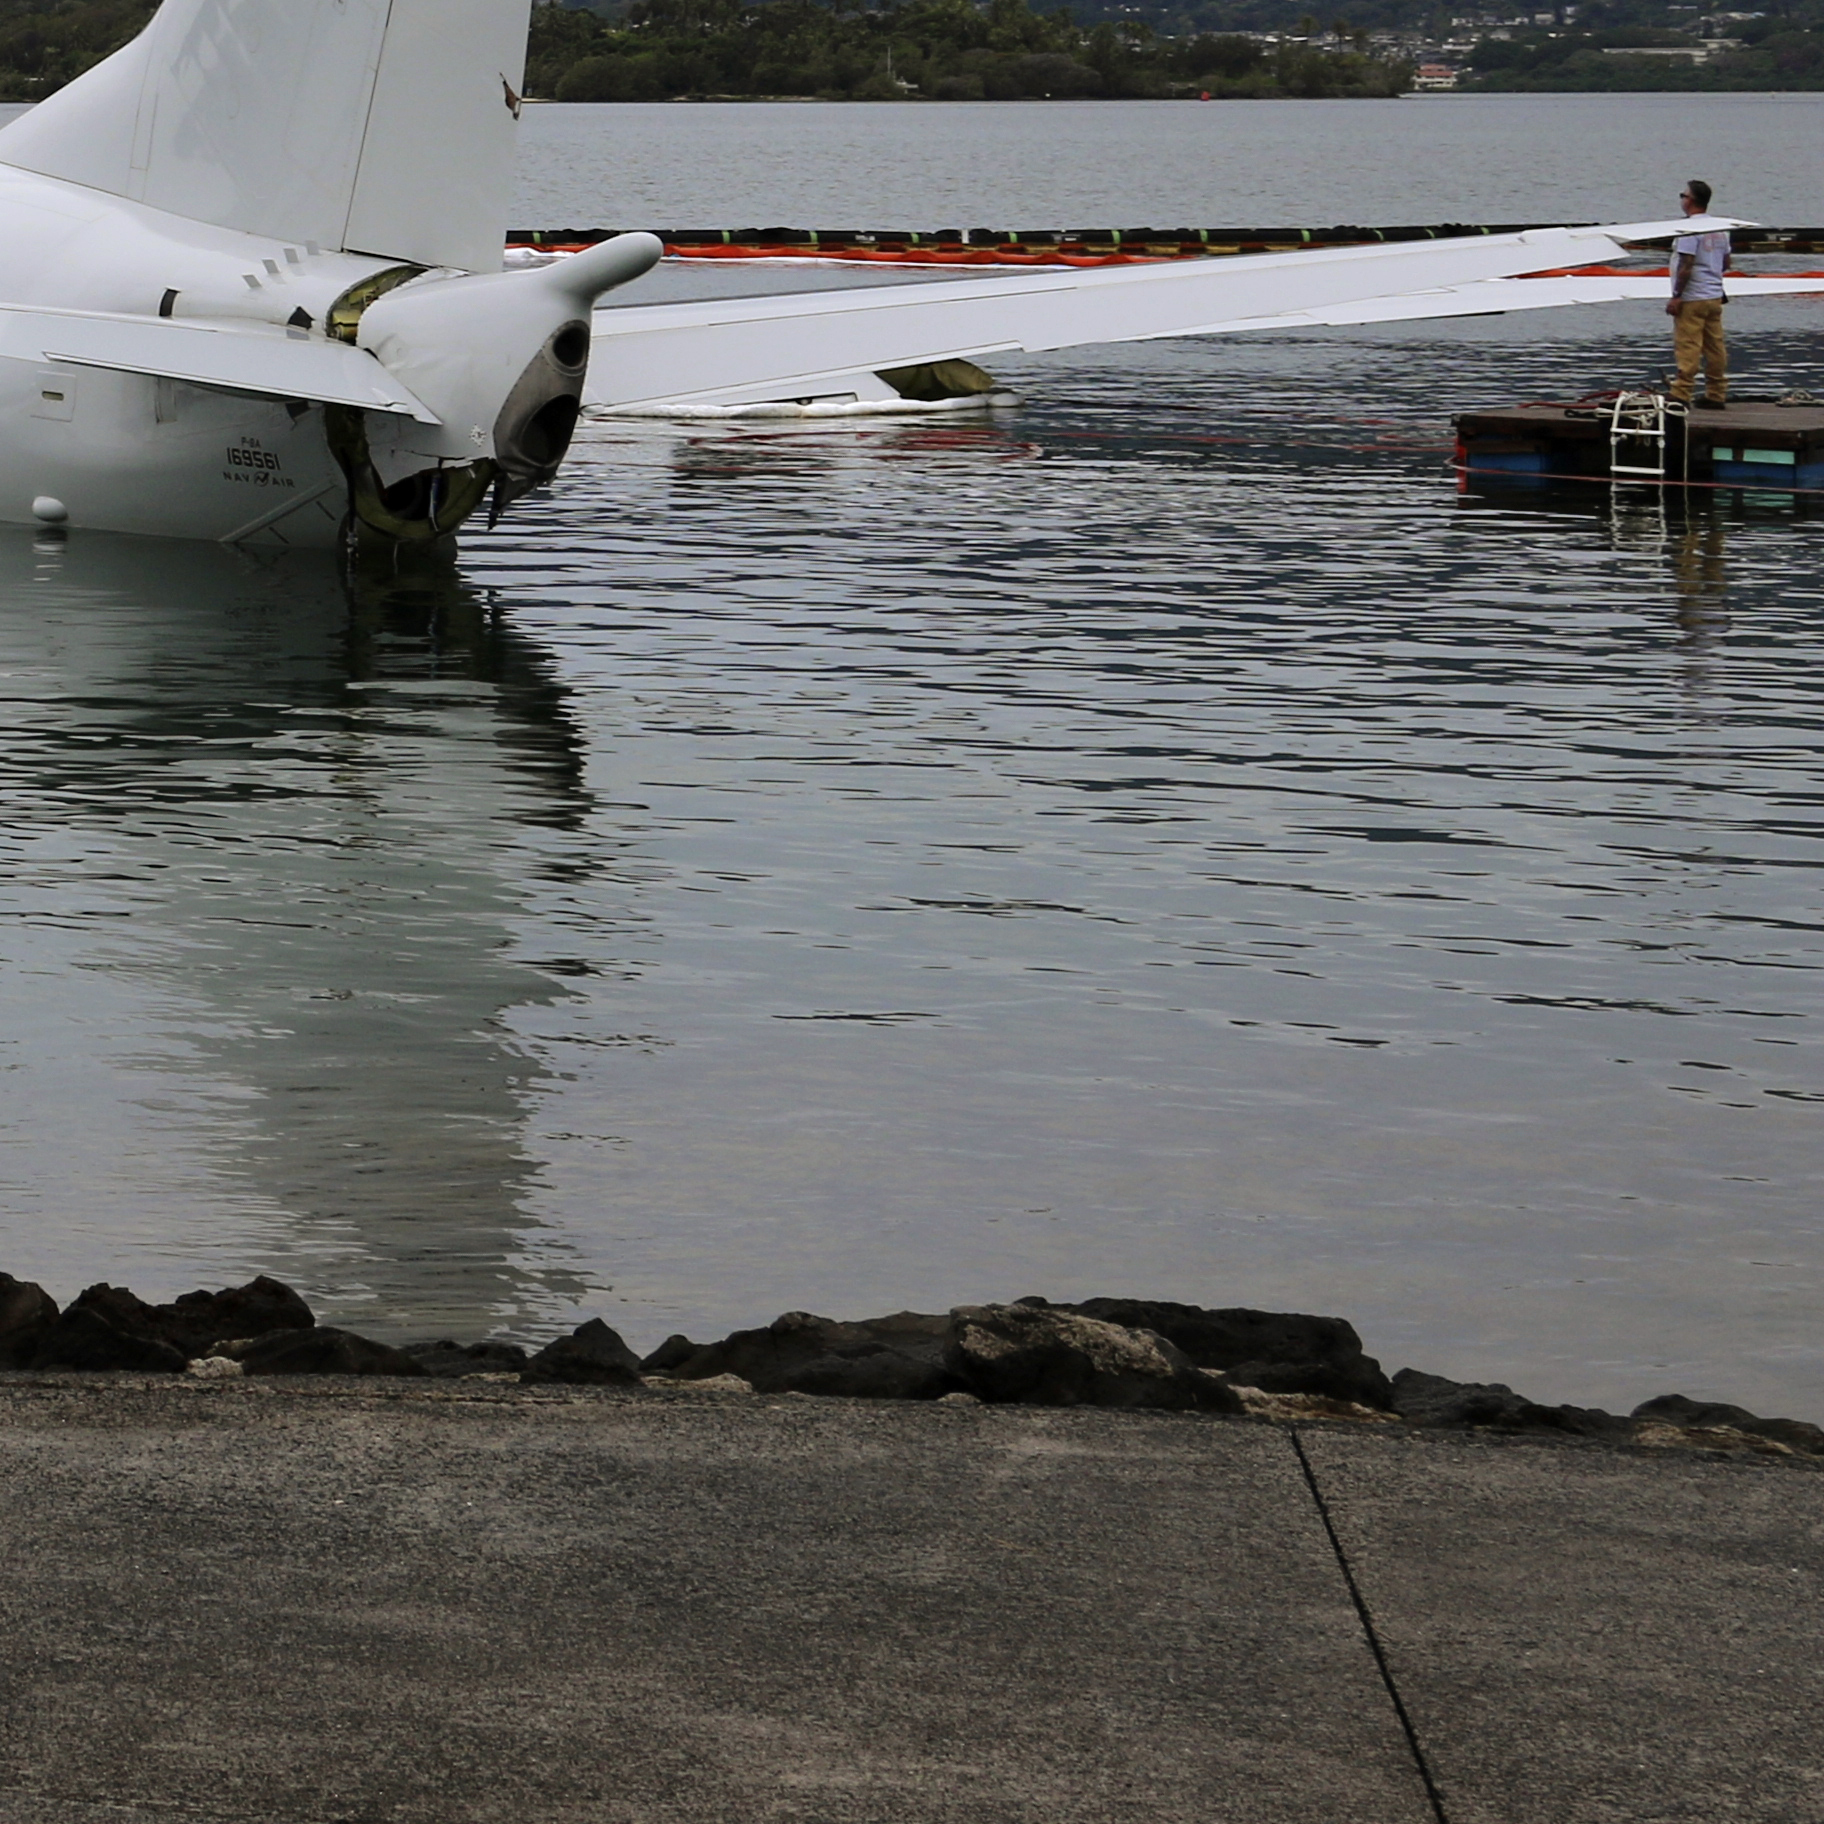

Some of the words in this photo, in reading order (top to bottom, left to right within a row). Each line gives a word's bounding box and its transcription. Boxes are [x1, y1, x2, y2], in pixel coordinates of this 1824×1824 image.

[241, 436, 261, 448] P-8A
[227, 447, 280, 470] 169561
[222, 471, 250, 483] NAV
[271, 477, 296, 488] AIR
